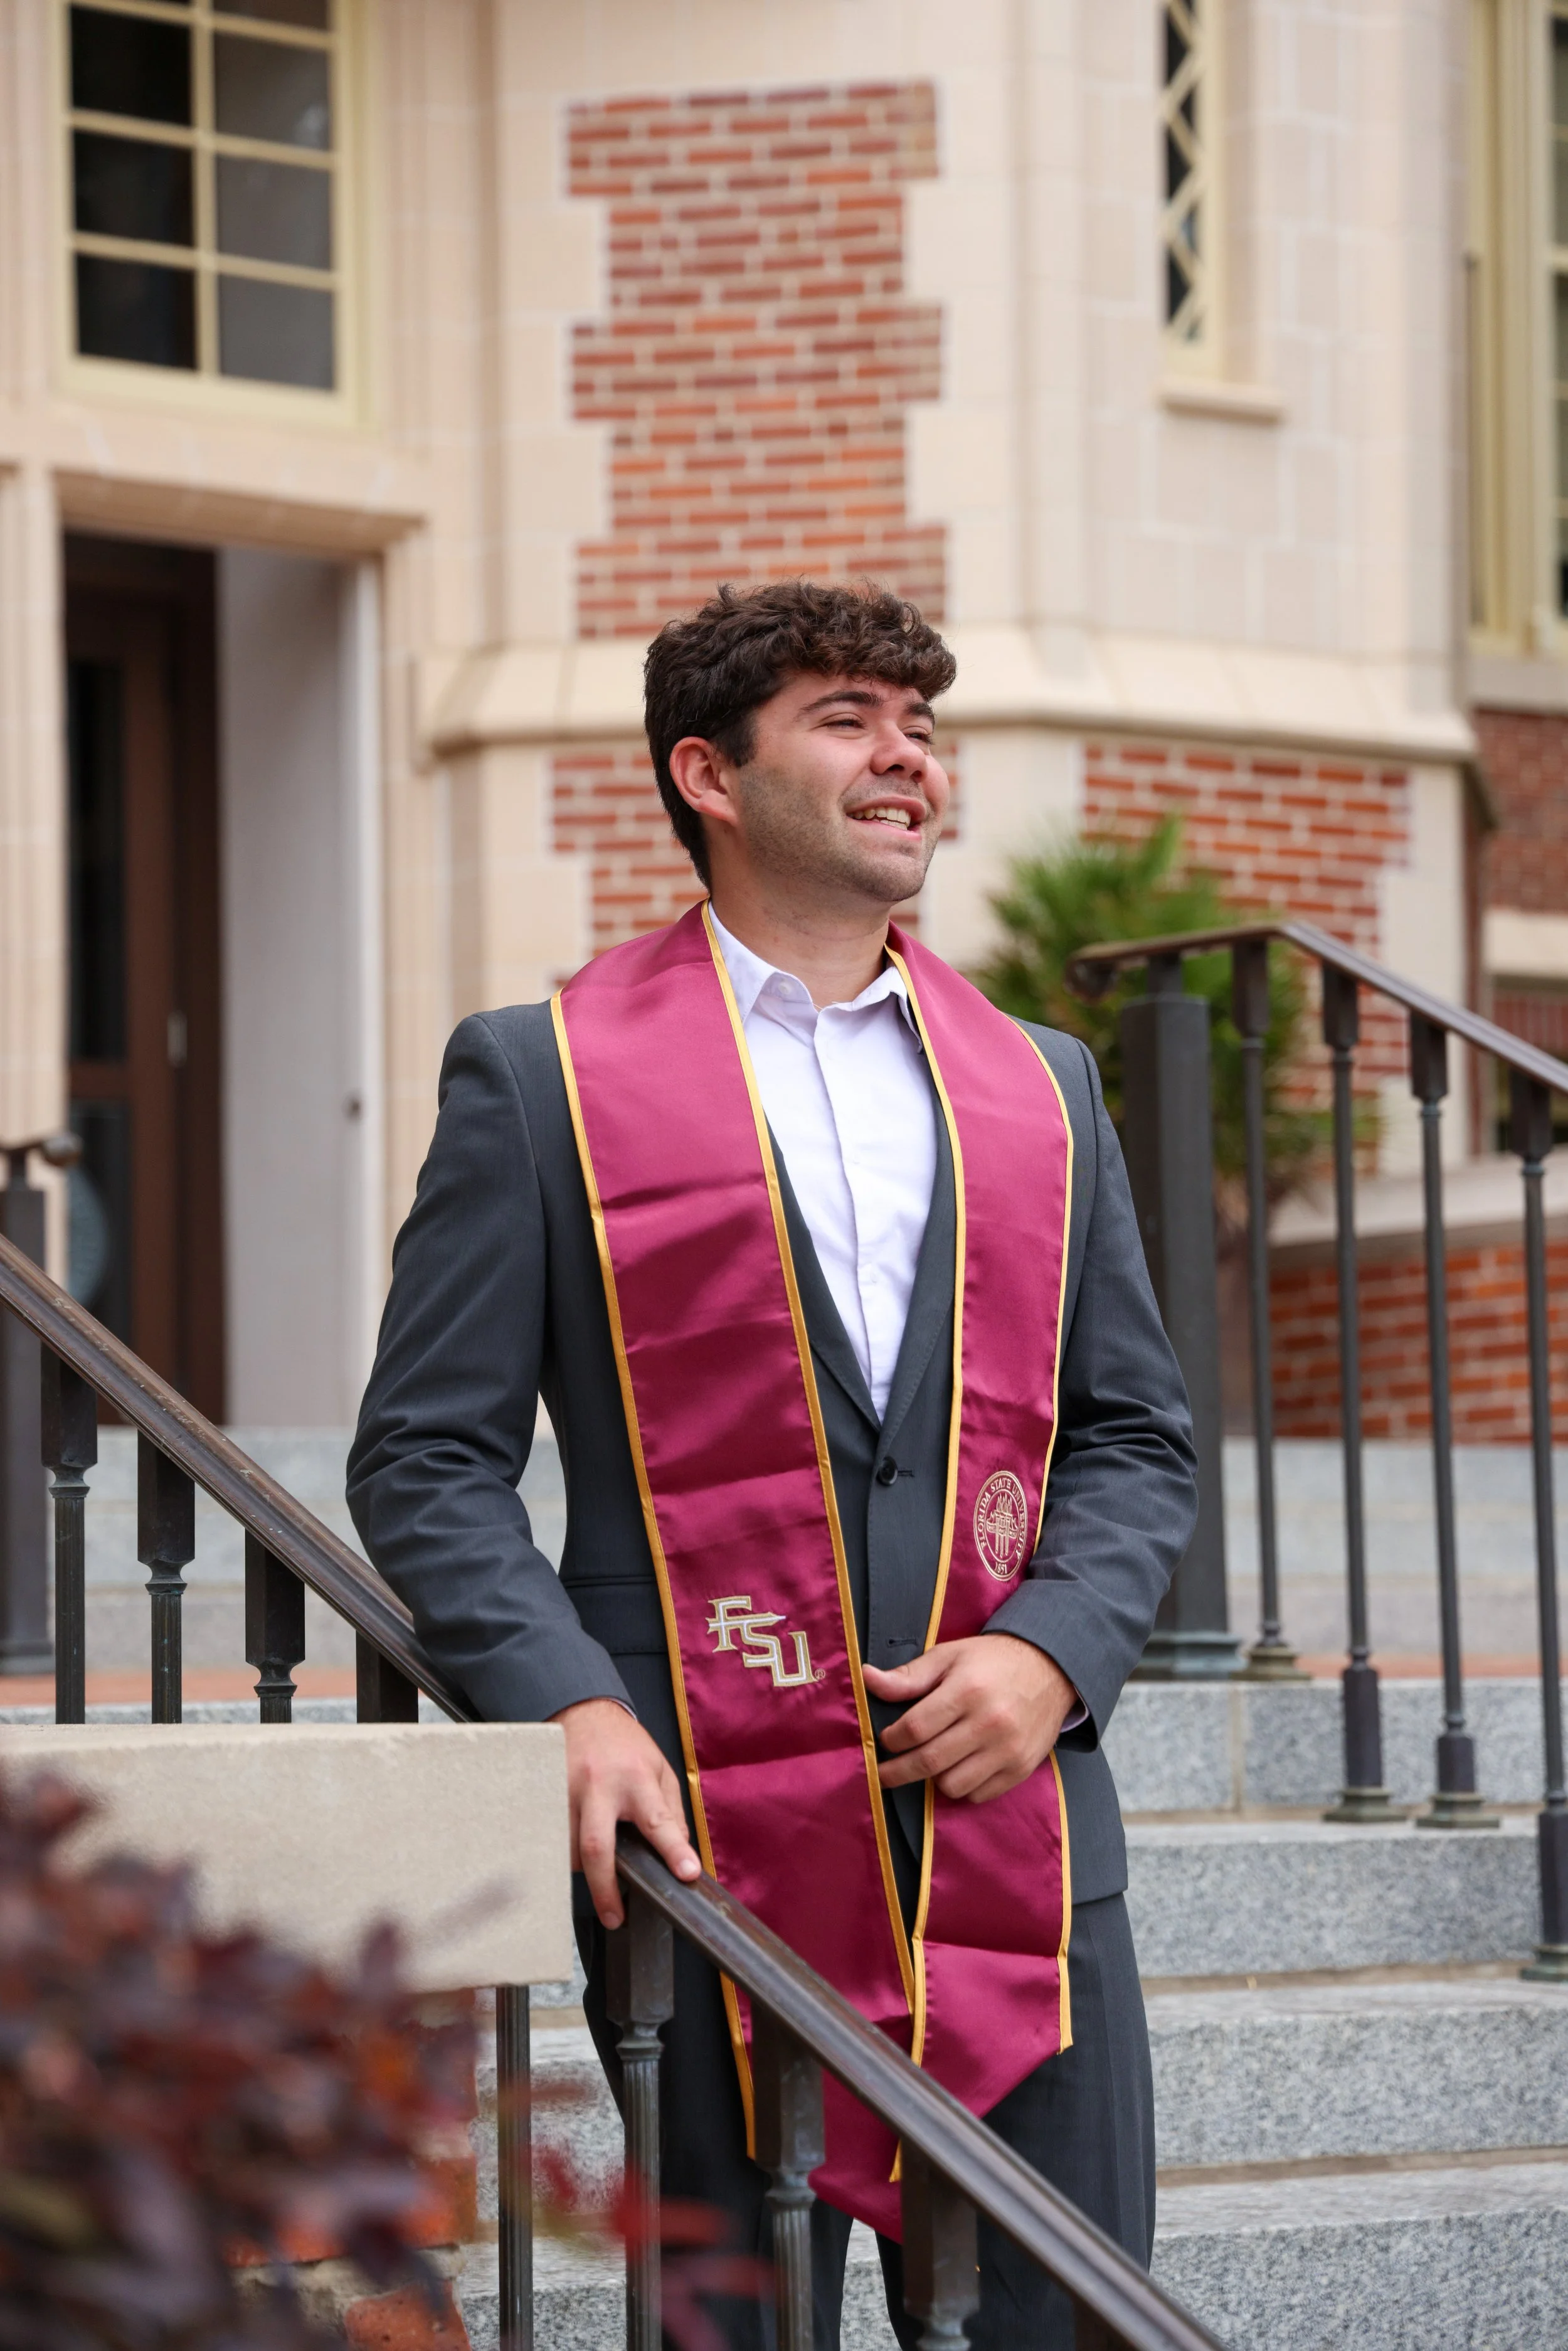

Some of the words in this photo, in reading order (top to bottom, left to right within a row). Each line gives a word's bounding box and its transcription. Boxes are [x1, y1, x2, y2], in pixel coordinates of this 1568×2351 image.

[978, 1492, 991, 1551] FLORIDA
[990, 1478, 1011, 1492] STATE
[1012, 1483, 1025, 1559] UNIVERSITY
[995, 1562, 1007, 1574] 1851
[706, 1595, 818, 1687] FSU
